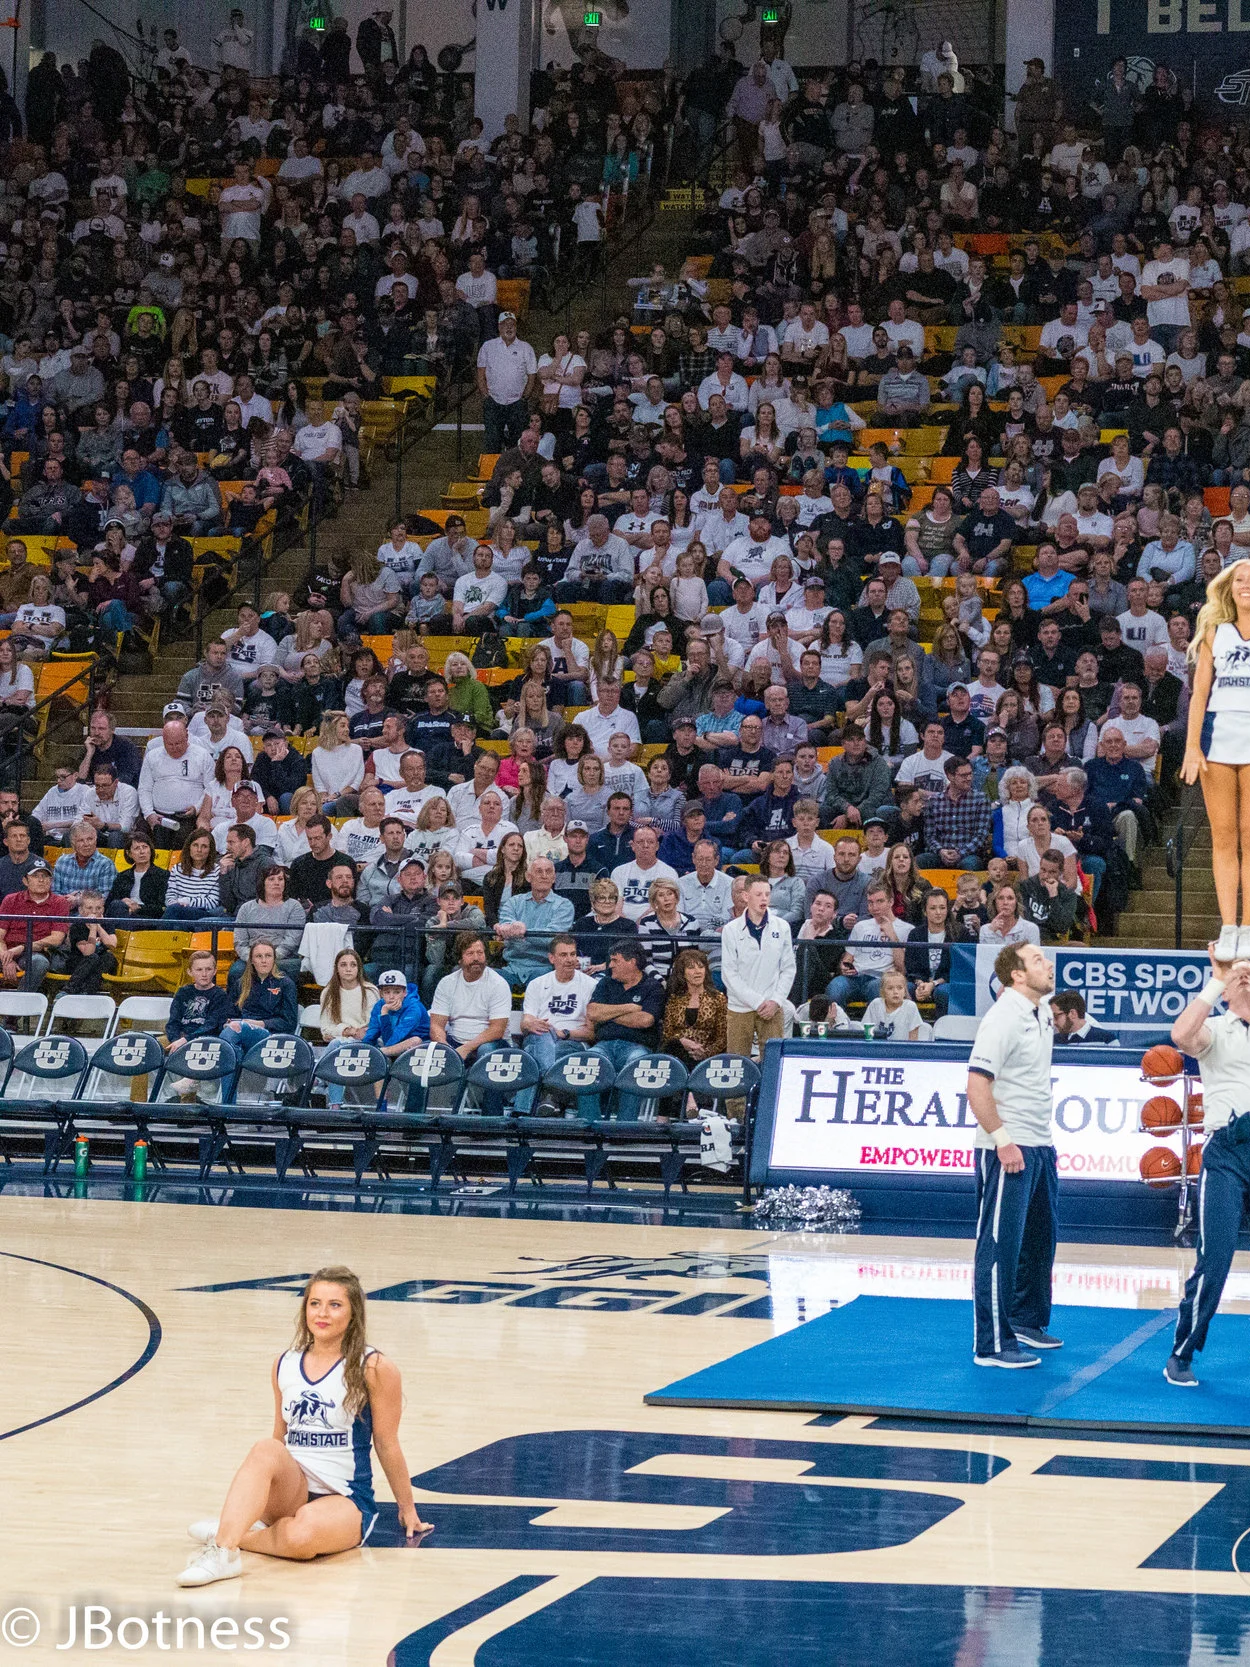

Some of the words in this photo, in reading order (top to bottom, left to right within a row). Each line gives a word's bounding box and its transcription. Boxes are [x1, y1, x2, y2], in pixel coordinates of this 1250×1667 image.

[583, 12, 600, 25] EXIT
[762, 8, 778, 21] EXIT
[309, 17, 325, 29] EXIT
[553, 658, 569, 674] A
[729, 767, 759, 776] STATE
[604, 774, 635, 785] GGIES
[623, 886, 650, 897] STAT
[1062, 961, 1127, 988] CBS
[1134, 962, 1213, 990] SPO
[548, 1000, 578, 1009] STATE
[1064, 989, 1228, 1017] ETWO
[34, 1049, 70, 1061] STATE
[111, 1046, 147, 1058] STATE
[185, 1050, 220, 1062] STATE
[261, 1047, 296, 1059] STATE
[334, 1056, 371, 1068] STATE
[409, 1056, 446, 1068] STTE
[485, 1062, 523, 1074] STATE
[563, 1065, 601, 1077] STATE
[633, 1068, 671, 1080] STATE
[706, 1067, 744, 1079] STATE
[861, 1066, 905, 1086] THE
[795, 1069, 978, 1129] HERAL
[860, 1145, 975, 1169] EMPOWERI
[1057, 1152, 1141, 1175] COMMU
[287, 1430, 310, 1447] UTAH
[311, 1430, 349, 1448] STATE
